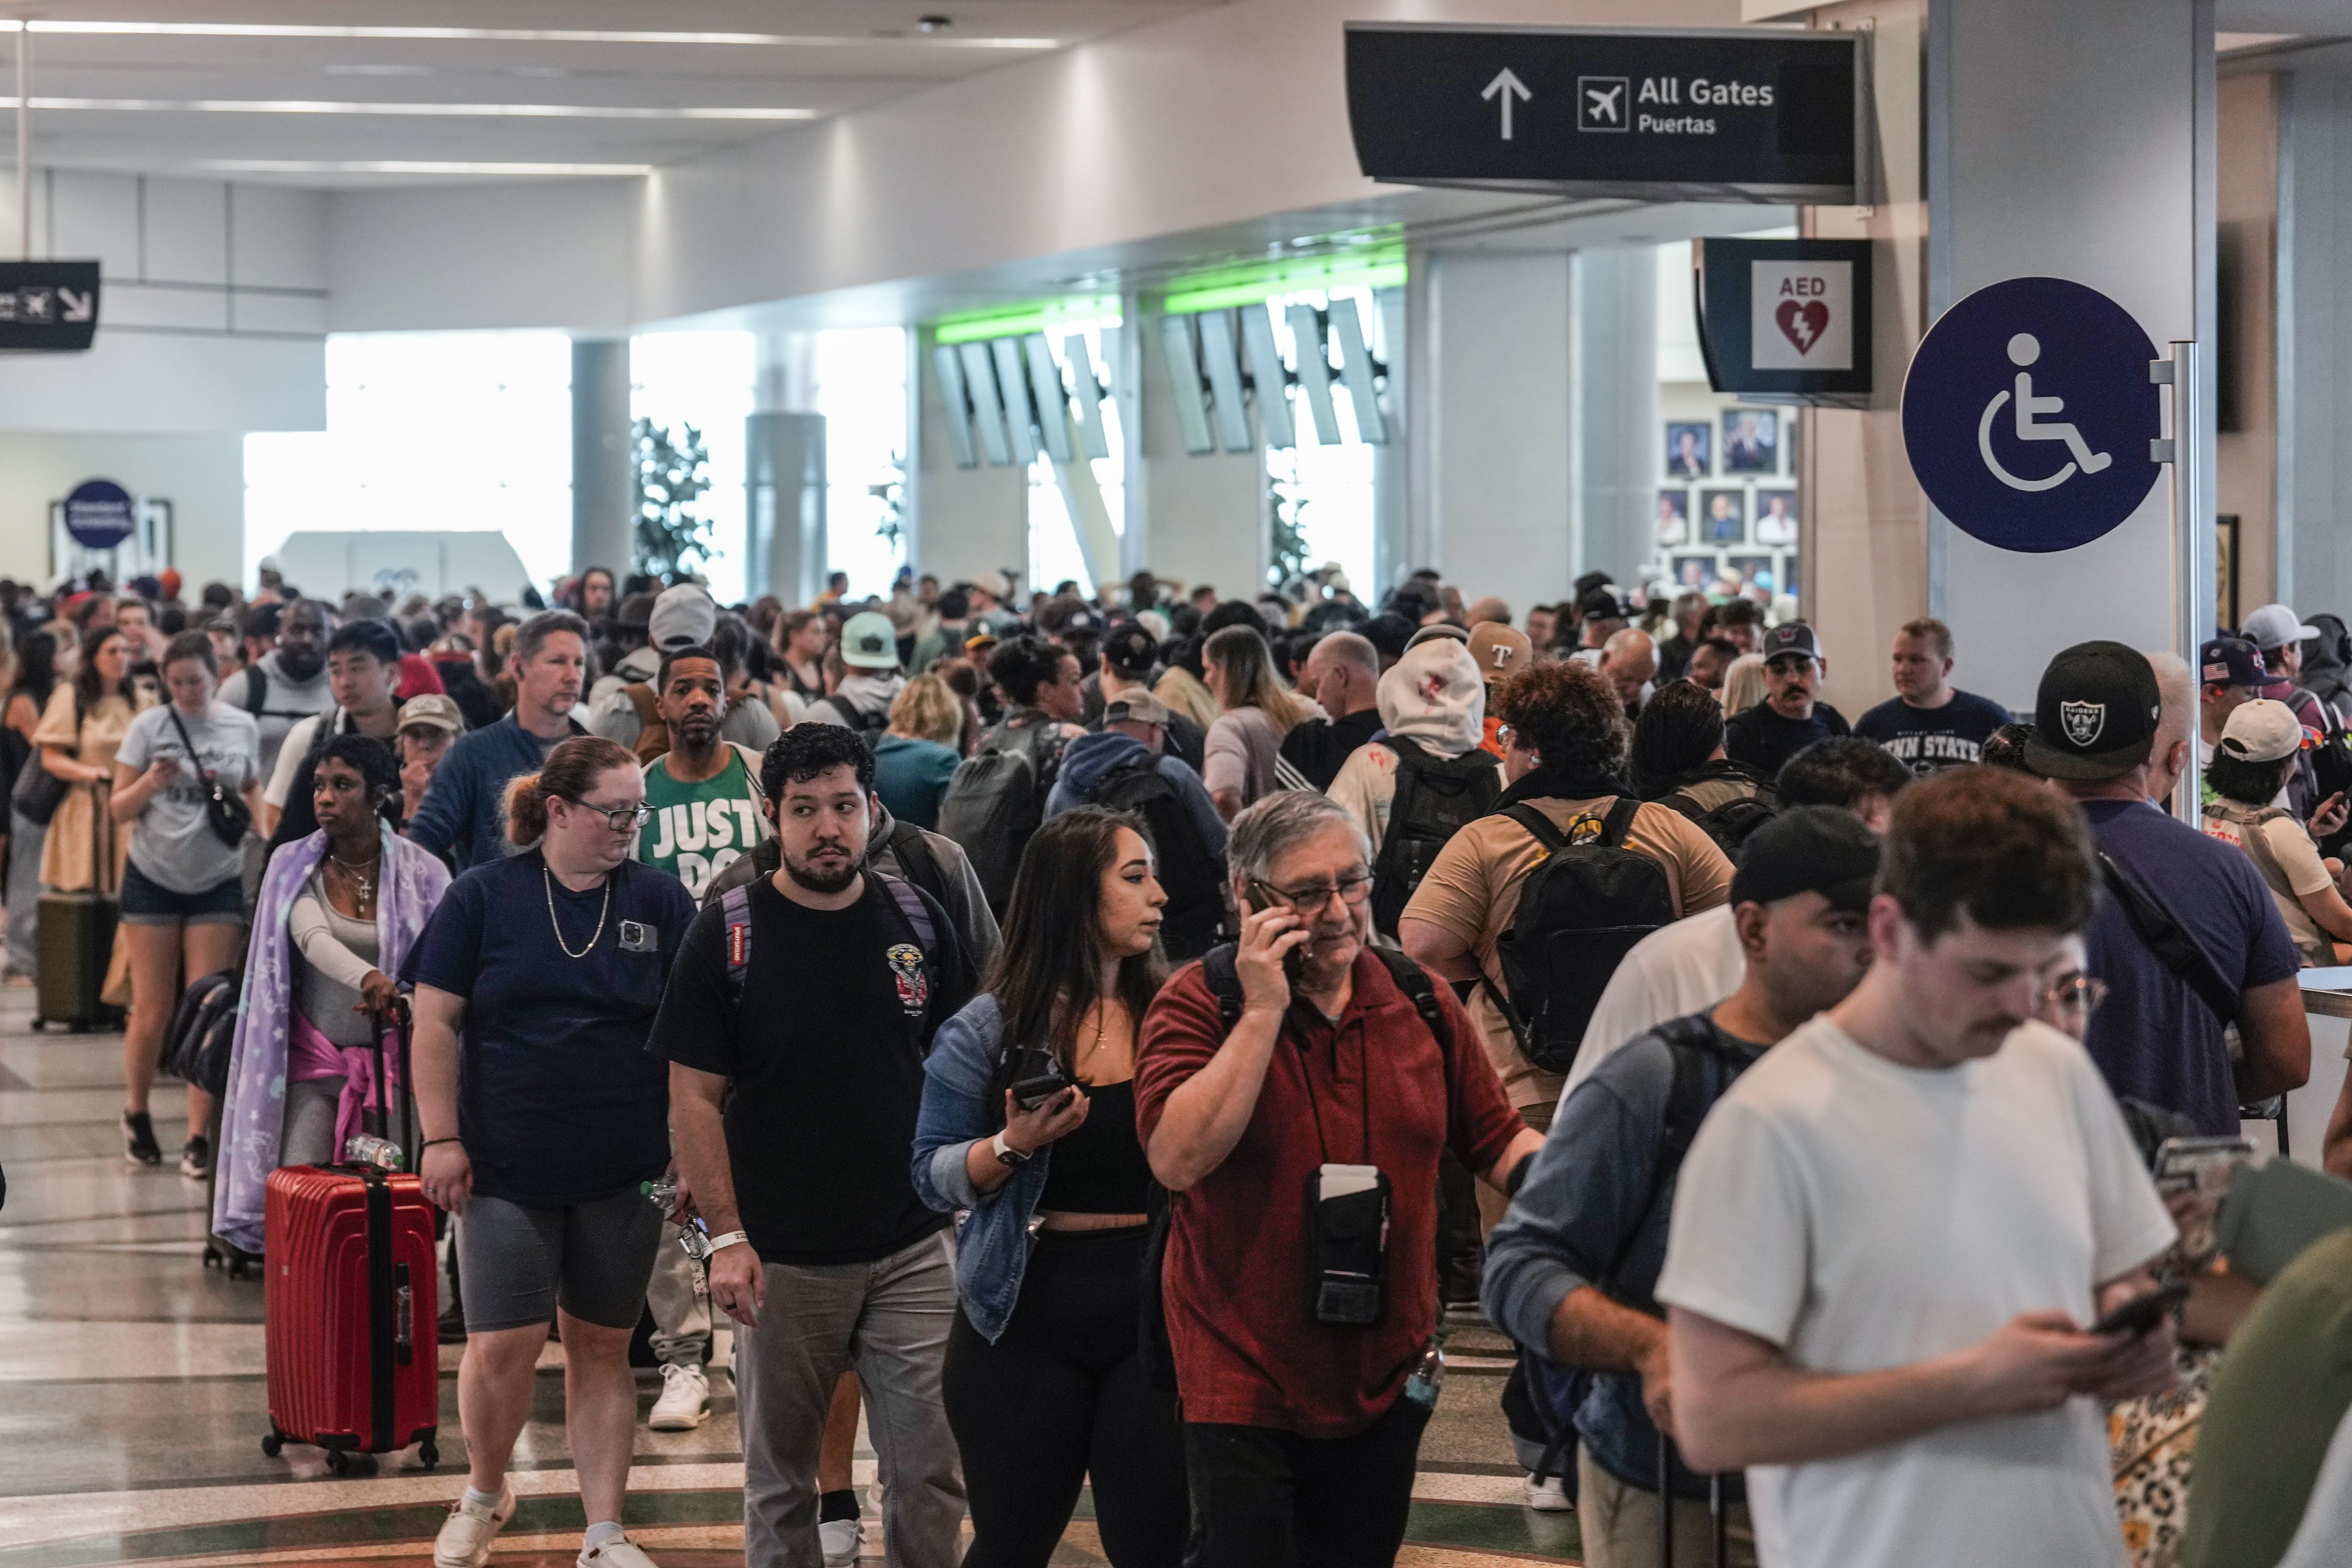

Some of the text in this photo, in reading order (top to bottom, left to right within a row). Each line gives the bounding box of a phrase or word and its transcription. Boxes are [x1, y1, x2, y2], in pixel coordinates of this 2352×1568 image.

[1637, 77, 1774, 106] All Gates
[1639, 114, 1717, 135] Puertas
[1780, 277, 1825, 295] AED
[1492, 645, 1512, 667] T
[1880, 736, 1979, 763] ENN STATE
[652, 798, 756, 858] JUST
